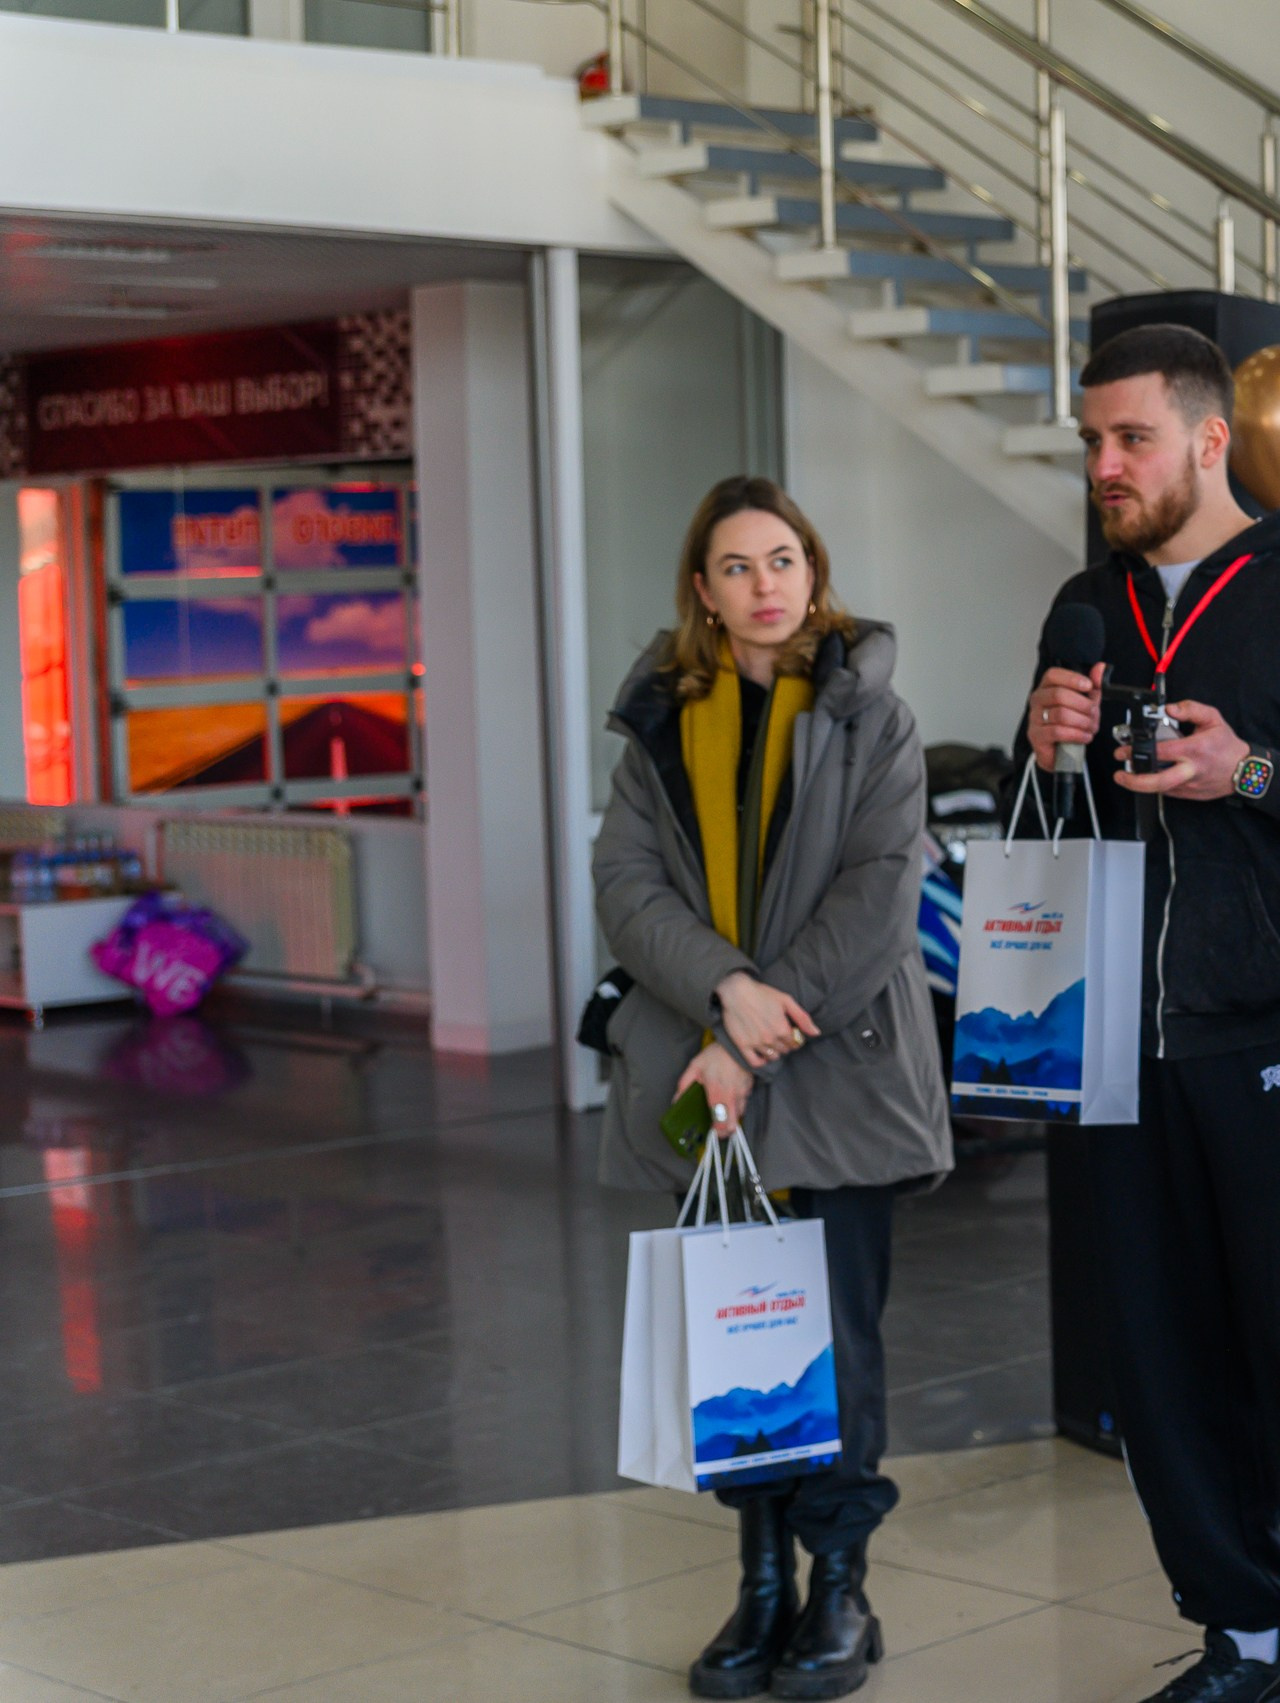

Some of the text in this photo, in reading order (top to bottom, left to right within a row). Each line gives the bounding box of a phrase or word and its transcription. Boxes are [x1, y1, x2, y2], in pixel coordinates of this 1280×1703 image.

[38, 388, 140, 430] СПАСИБО
[143, 385, 173, 422] ЗА
[175, 379, 231, 419] ВАШ
[982, 918, 1033, 933] АКТИВНЫЙ
[716, 1300, 765, 1319] АКТИВНЫЙ
